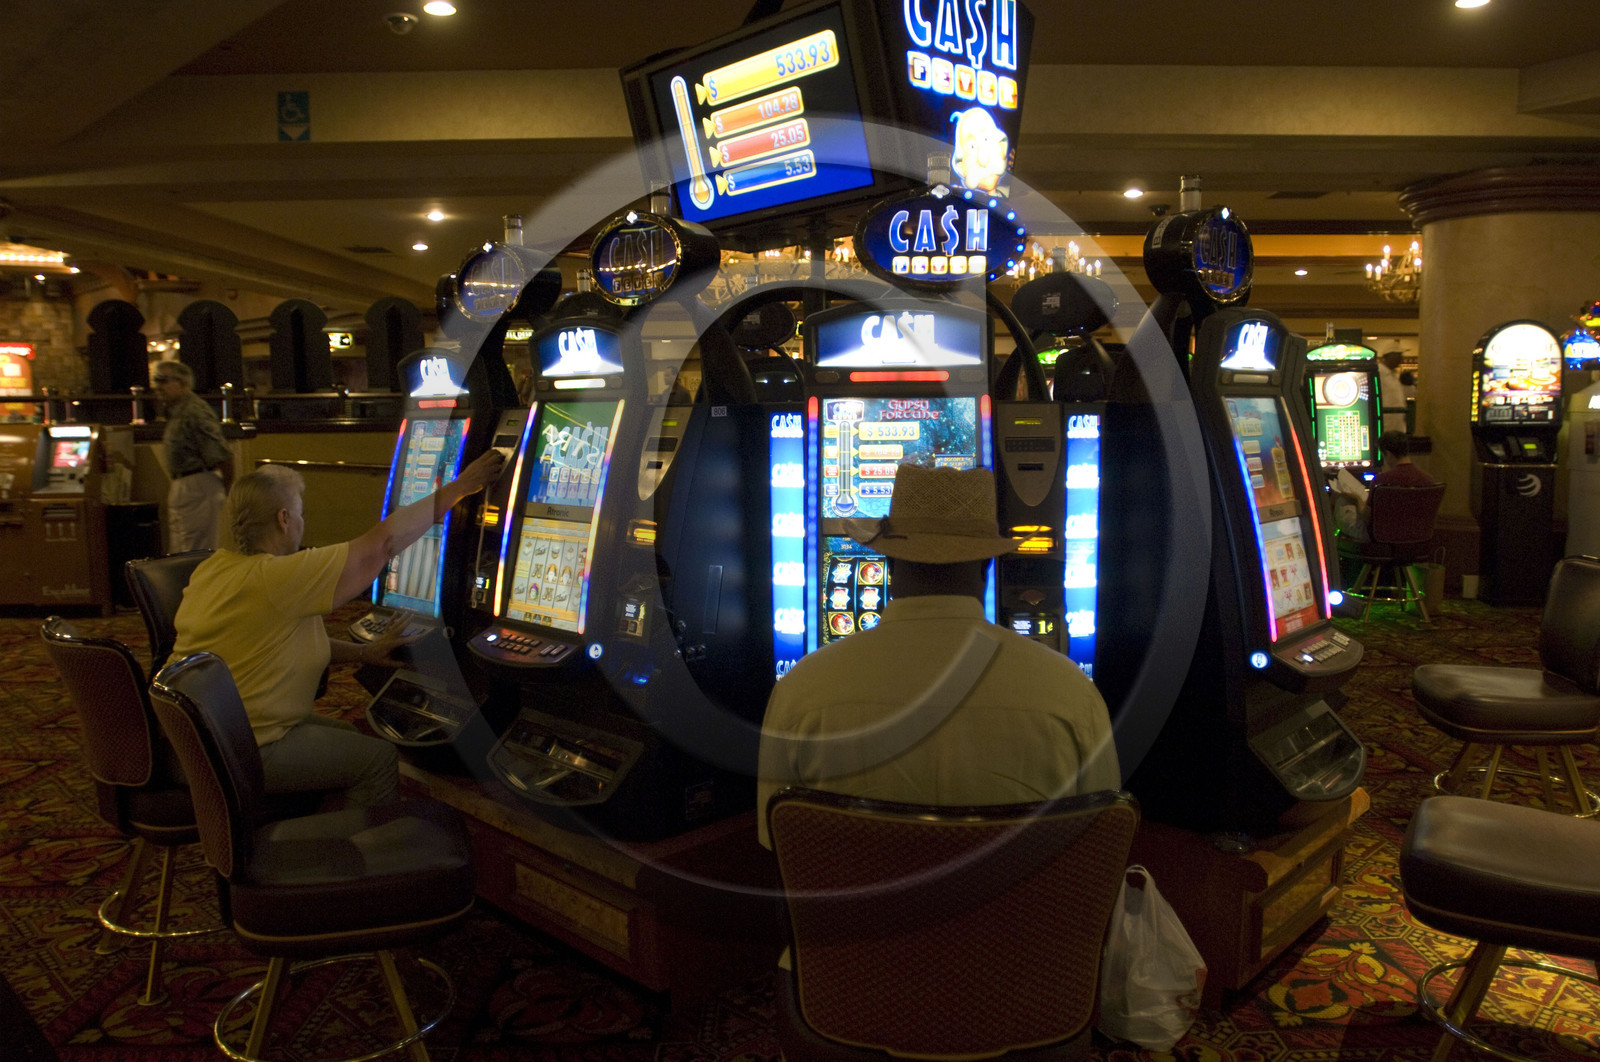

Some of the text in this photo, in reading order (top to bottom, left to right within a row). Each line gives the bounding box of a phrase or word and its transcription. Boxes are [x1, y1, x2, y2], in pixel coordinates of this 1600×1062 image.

[709, 39, 831, 100] $ 533.93
[907, 50, 1018, 111] FEVER
[715, 93, 799, 133] $ 104.28
[722, 124, 806, 162] $ 25.05
[727, 158, 811, 191] $ 5.53
[878, 425, 915, 437] 533.93
[873, 465, 896, 475] 25.05
[873, 484, 891, 494] 5.53
[1038, 621, 1054, 635] 1¢
